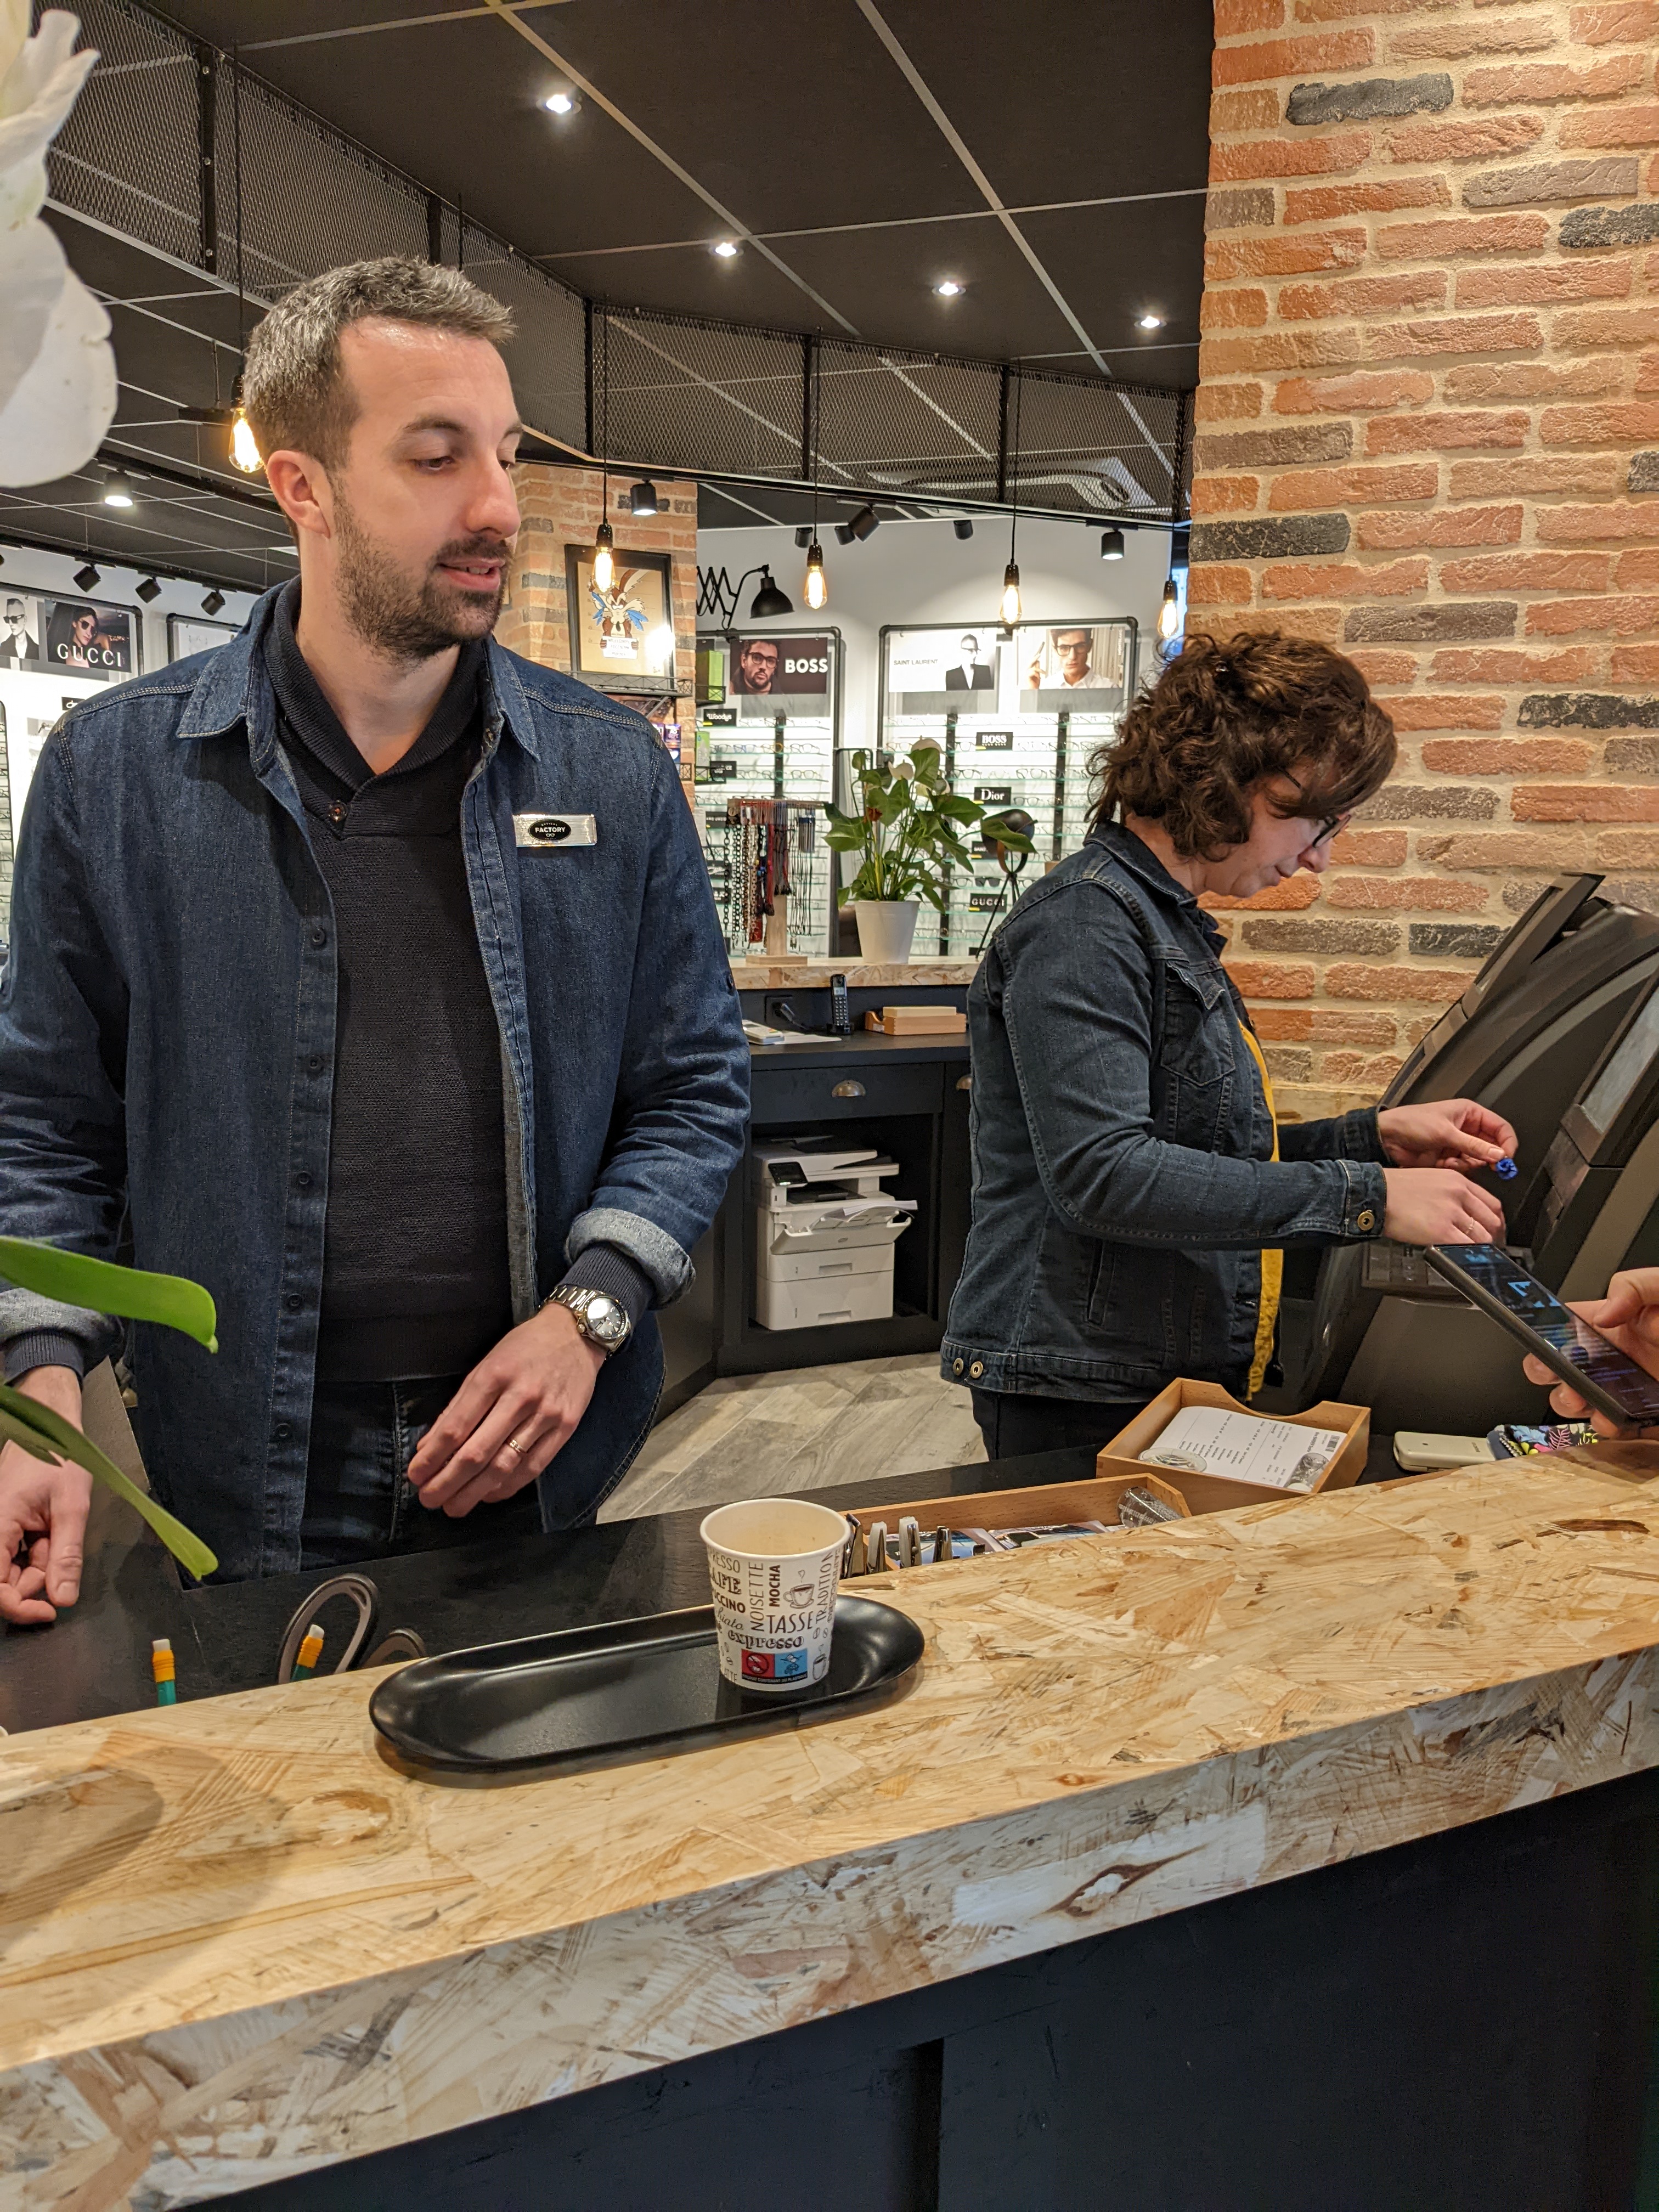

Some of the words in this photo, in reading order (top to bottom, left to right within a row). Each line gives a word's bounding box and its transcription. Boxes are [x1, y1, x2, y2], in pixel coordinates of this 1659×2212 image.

[57, 643, 122, 667] GUCCI
[785, 658, 828, 674] BOSS
[706, 712, 732, 721] Woodys
[981, 734, 1007, 743] BOSS
[980, 788, 1005, 800] Dior
[972, 898, 1005, 907] GUCCI
[769, 1565, 781, 1607] MOCHA
[816, 1552, 833, 1624] TRADITION
[748, 1562, 764, 1632] NOISETTE
[766, 1611, 813, 1634] TASSE
[727, 1629, 804, 1649] expresso
